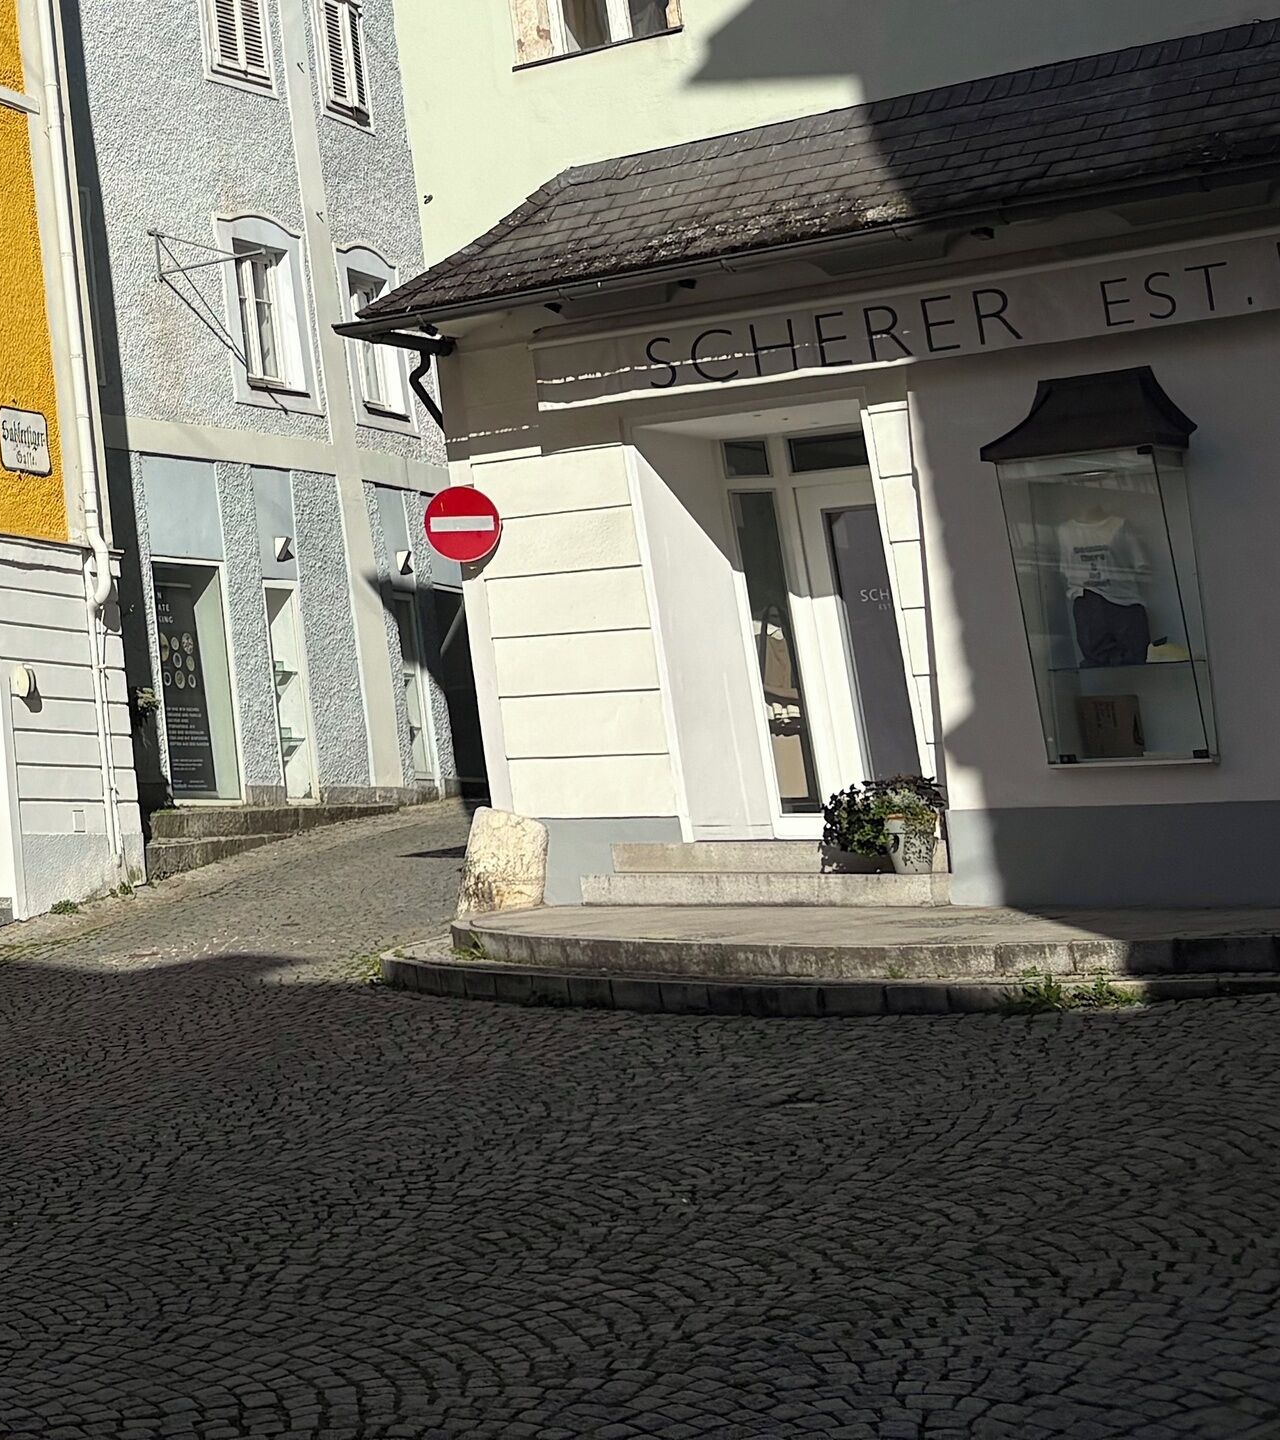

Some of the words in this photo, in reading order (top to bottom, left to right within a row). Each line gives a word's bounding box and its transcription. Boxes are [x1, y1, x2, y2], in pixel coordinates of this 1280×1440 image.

[644, 288, 1024, 390] SCHERER
[1099, 262, 1254, 327] EST.
[860, 588, 890, 602] SCH
